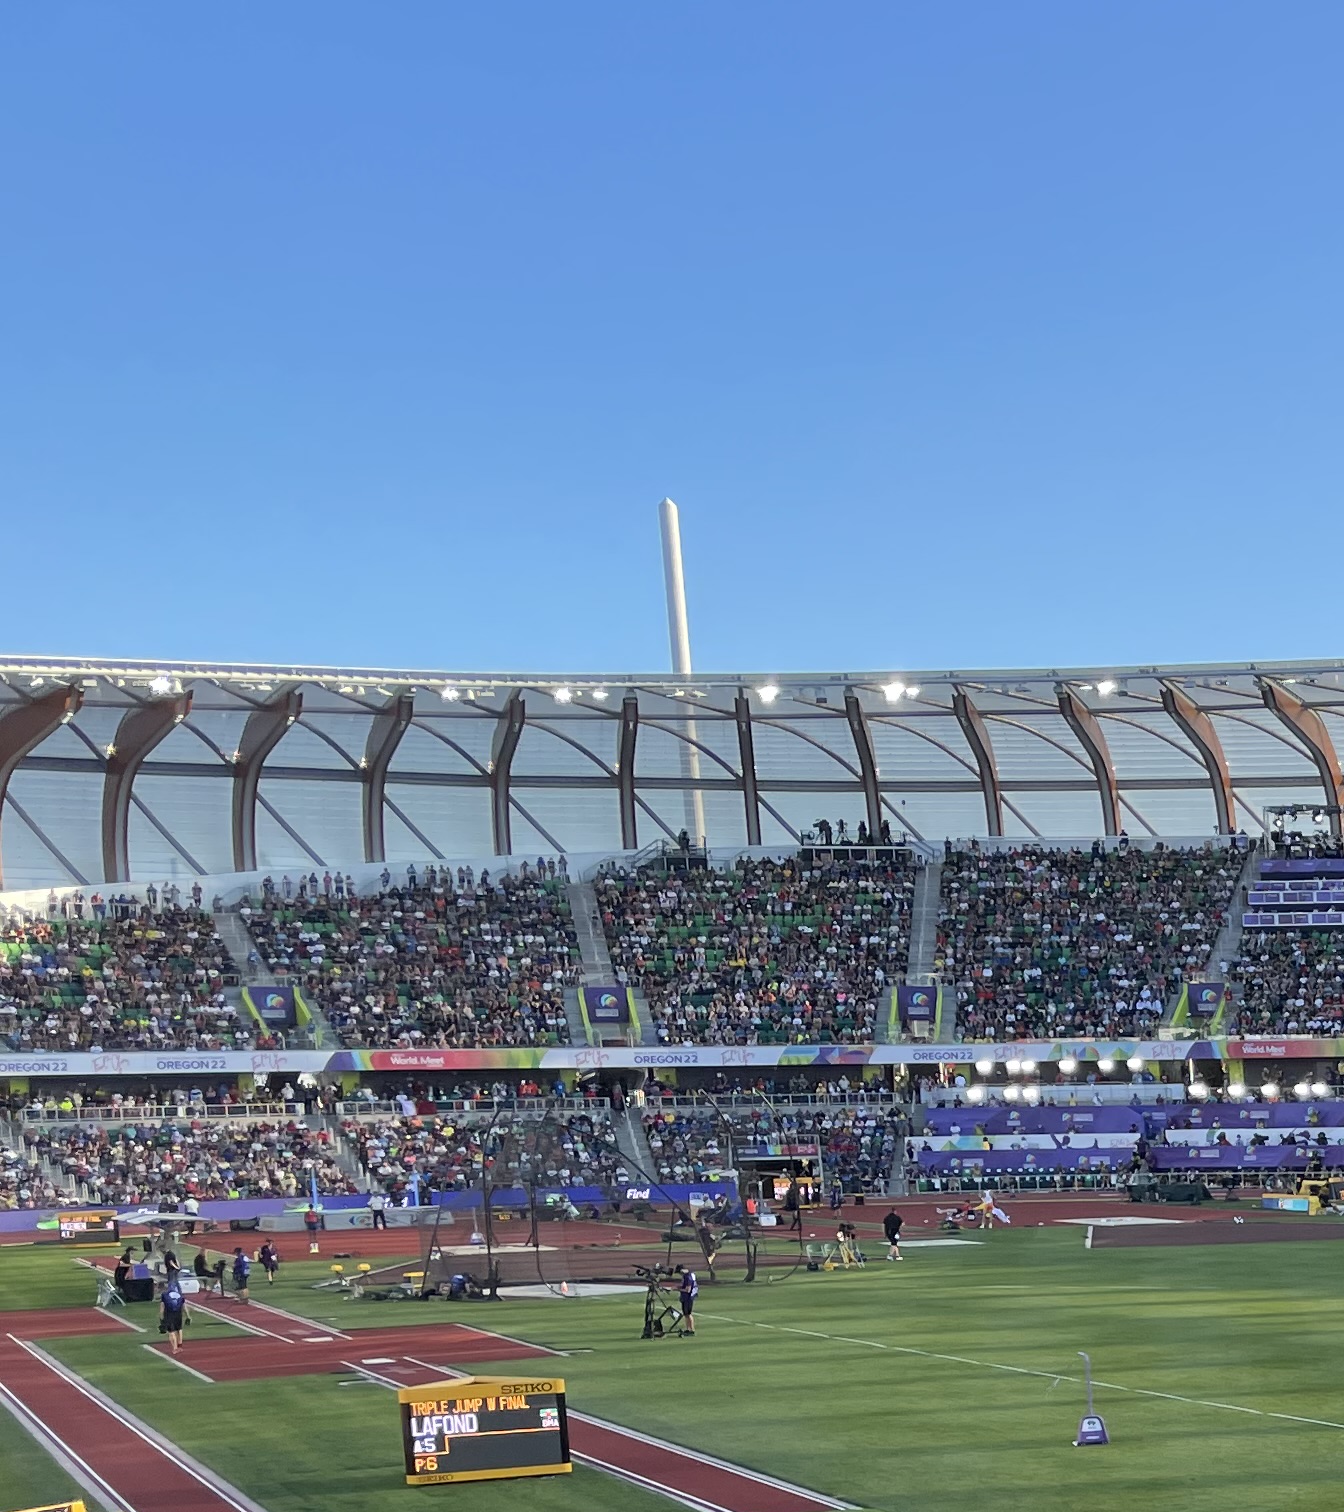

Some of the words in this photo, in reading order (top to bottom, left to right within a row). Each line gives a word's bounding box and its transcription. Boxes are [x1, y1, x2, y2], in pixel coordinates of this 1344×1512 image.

[420, 1055, 444, 1065] Meet
[634, 1055, 682, 1064] OREGON
[683, 1054, 698, 1064] 22
[913, 1051, 958, 1061] OREGON
[959, 1051, 973, 1060] 22
[0, 1062, 51, 1072] OREGON
[52, 1061, 68, 1072] 22
[157, 1060, 209, 1070] OREGON
[211, 1060, 227, 1069] 22
[627, 1188, 650, 1200] Find
[501, 1382, 553, 1395] SEIKO
[411, 1400, 449, 1416] TRIPLE
[452, 1398, 482, 1414] JUMP
[486, 1397, 496, 1411] W
[499, 1395, 530, 1411] FINAL
[411, 1413, 478, 1437] LAFOND
[414, 1457, 438, 1472] P:6
